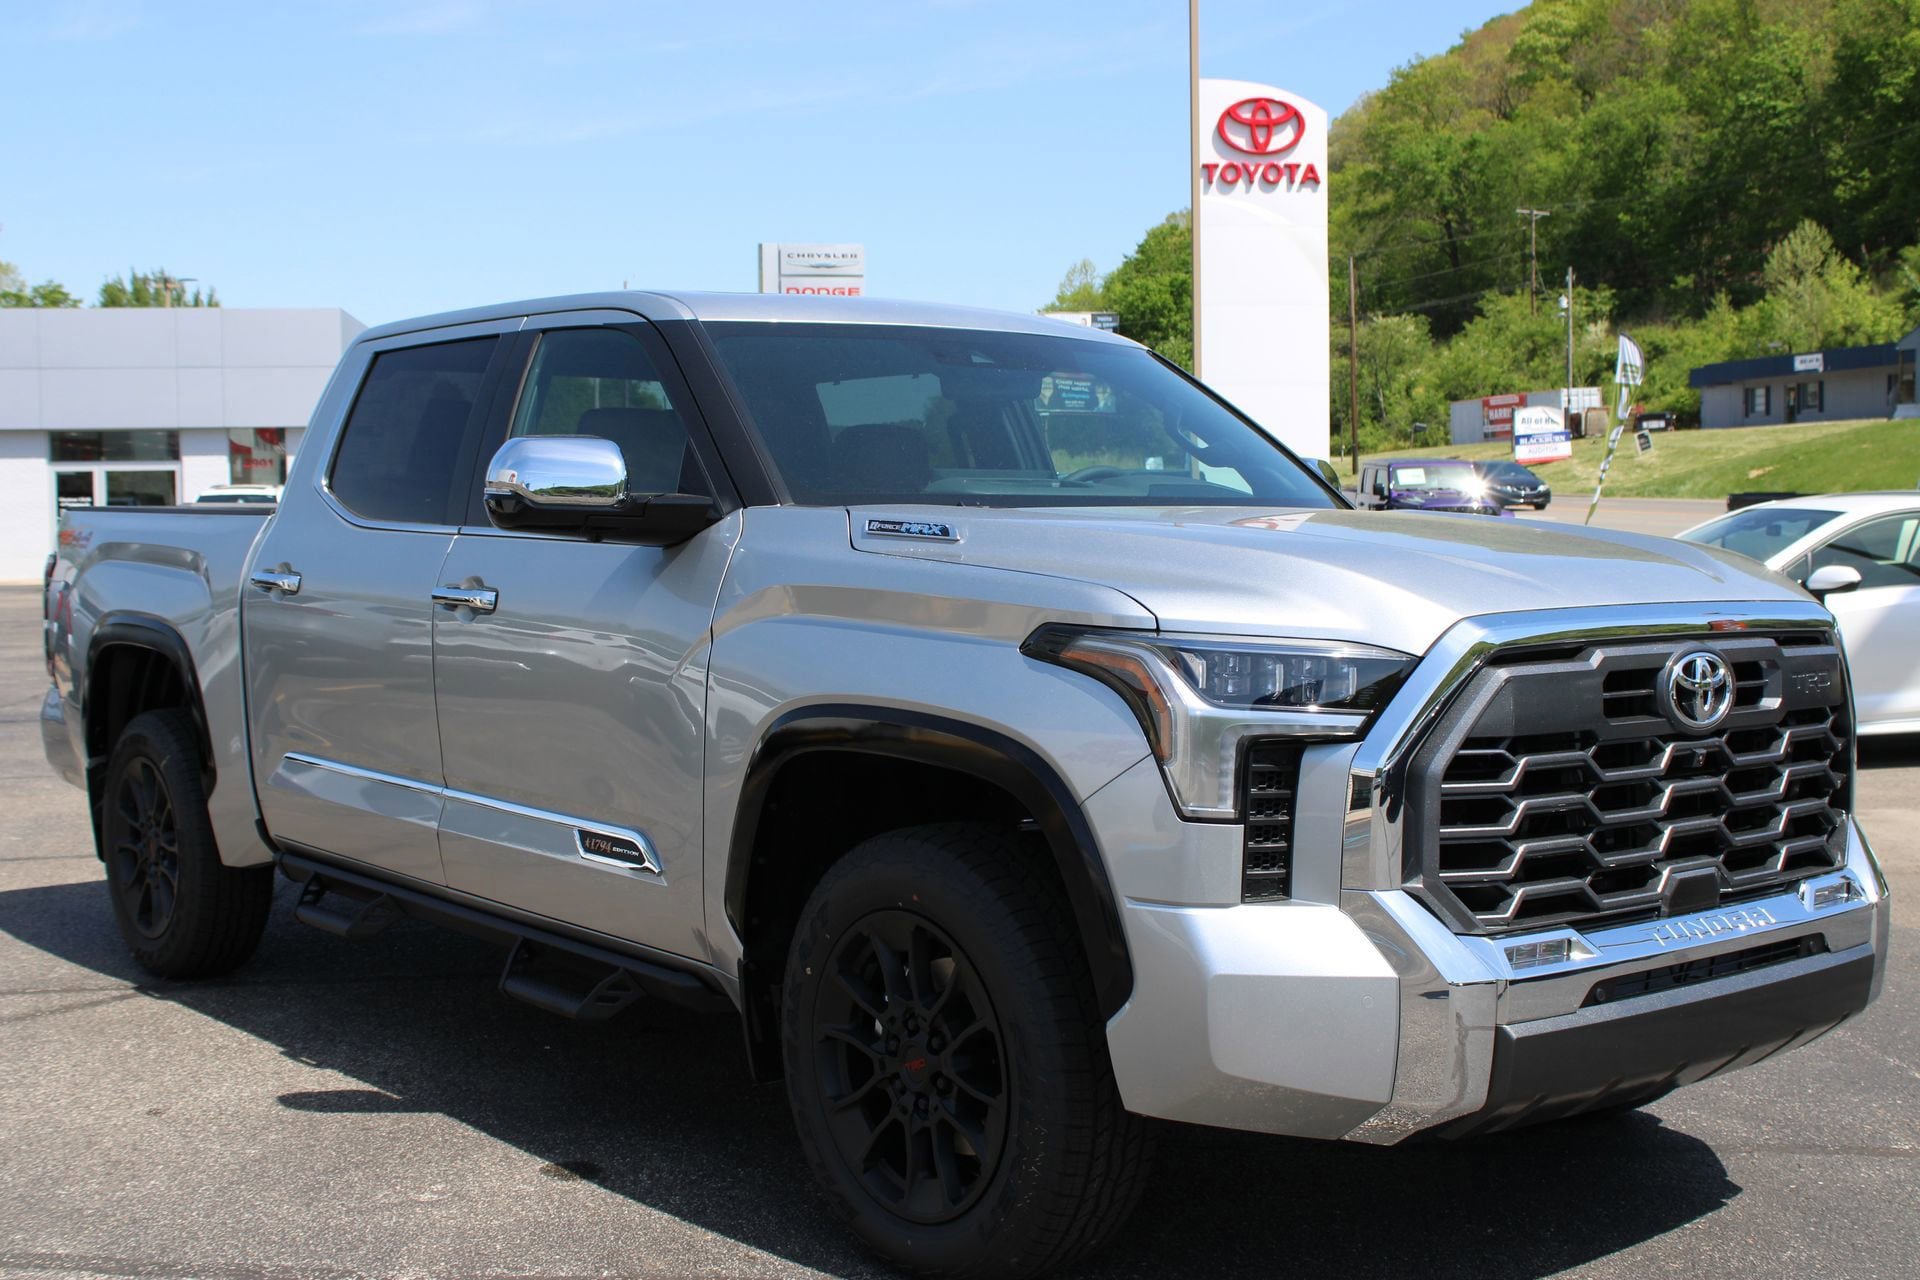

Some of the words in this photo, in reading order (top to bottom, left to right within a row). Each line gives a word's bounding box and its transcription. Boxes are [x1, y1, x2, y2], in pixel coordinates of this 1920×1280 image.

[1201, 162, 1321, 185] TOYOTA
[785, 286, 861, 296] DODGE
[1519, 433, 1566, 446] BLACKBURN
[900, 522, 946, 536] MAX
[612, 846, 640, 857] EDITION
